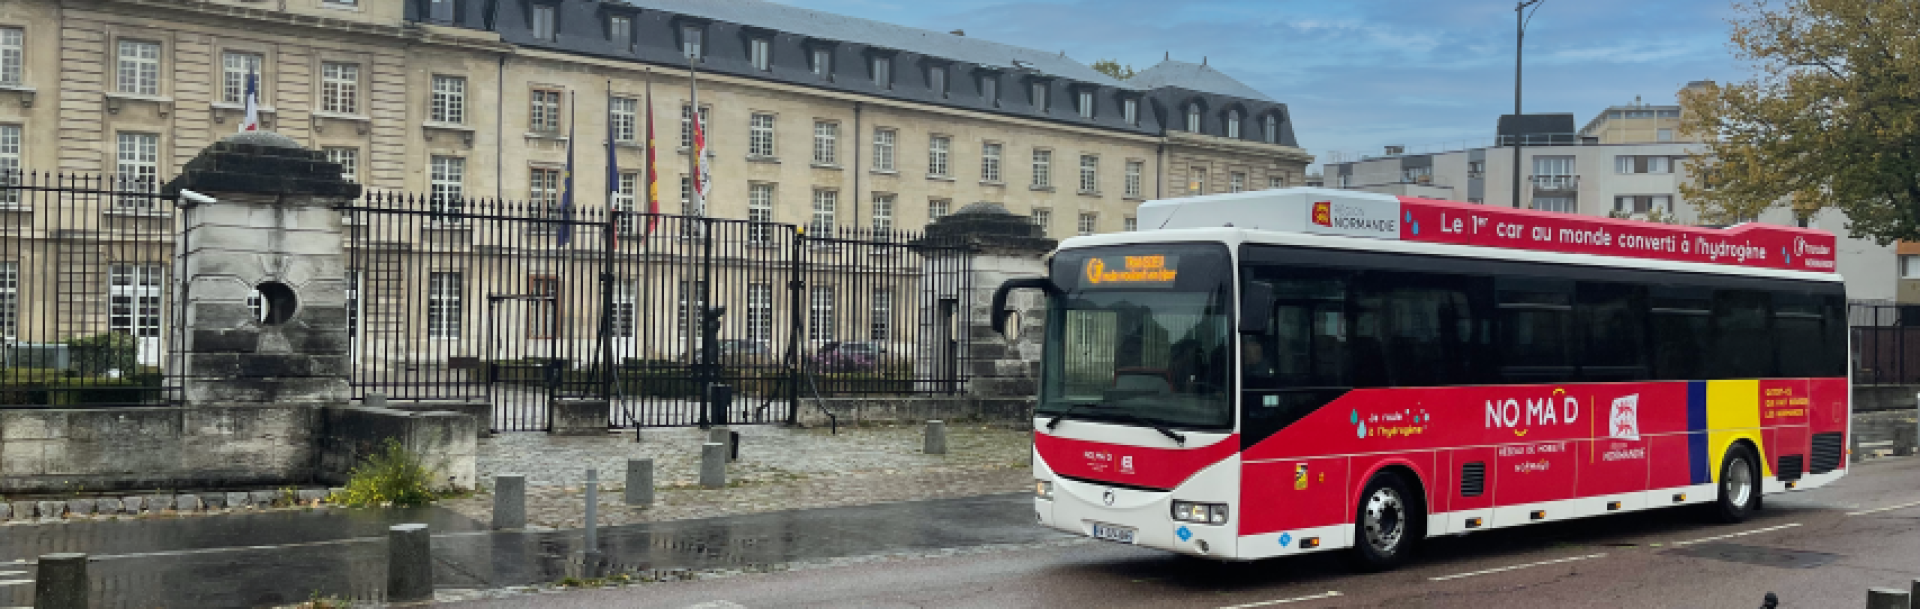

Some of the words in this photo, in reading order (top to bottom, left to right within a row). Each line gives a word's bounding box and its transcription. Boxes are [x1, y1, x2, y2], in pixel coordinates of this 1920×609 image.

[1334, 216, 1396, 232] NORMANDIE
[1440, 211, 1463, 234] Le
[1496, 221, 1524, 239] car
[1532, 226, 1552, 242] au
[1559, 226, 1612, 246] monde
[1618, 232, 1676, 253] converti
[1681, 233, 1690, 254] à
[1694, 236, 1766, 263] l'hydrogène
